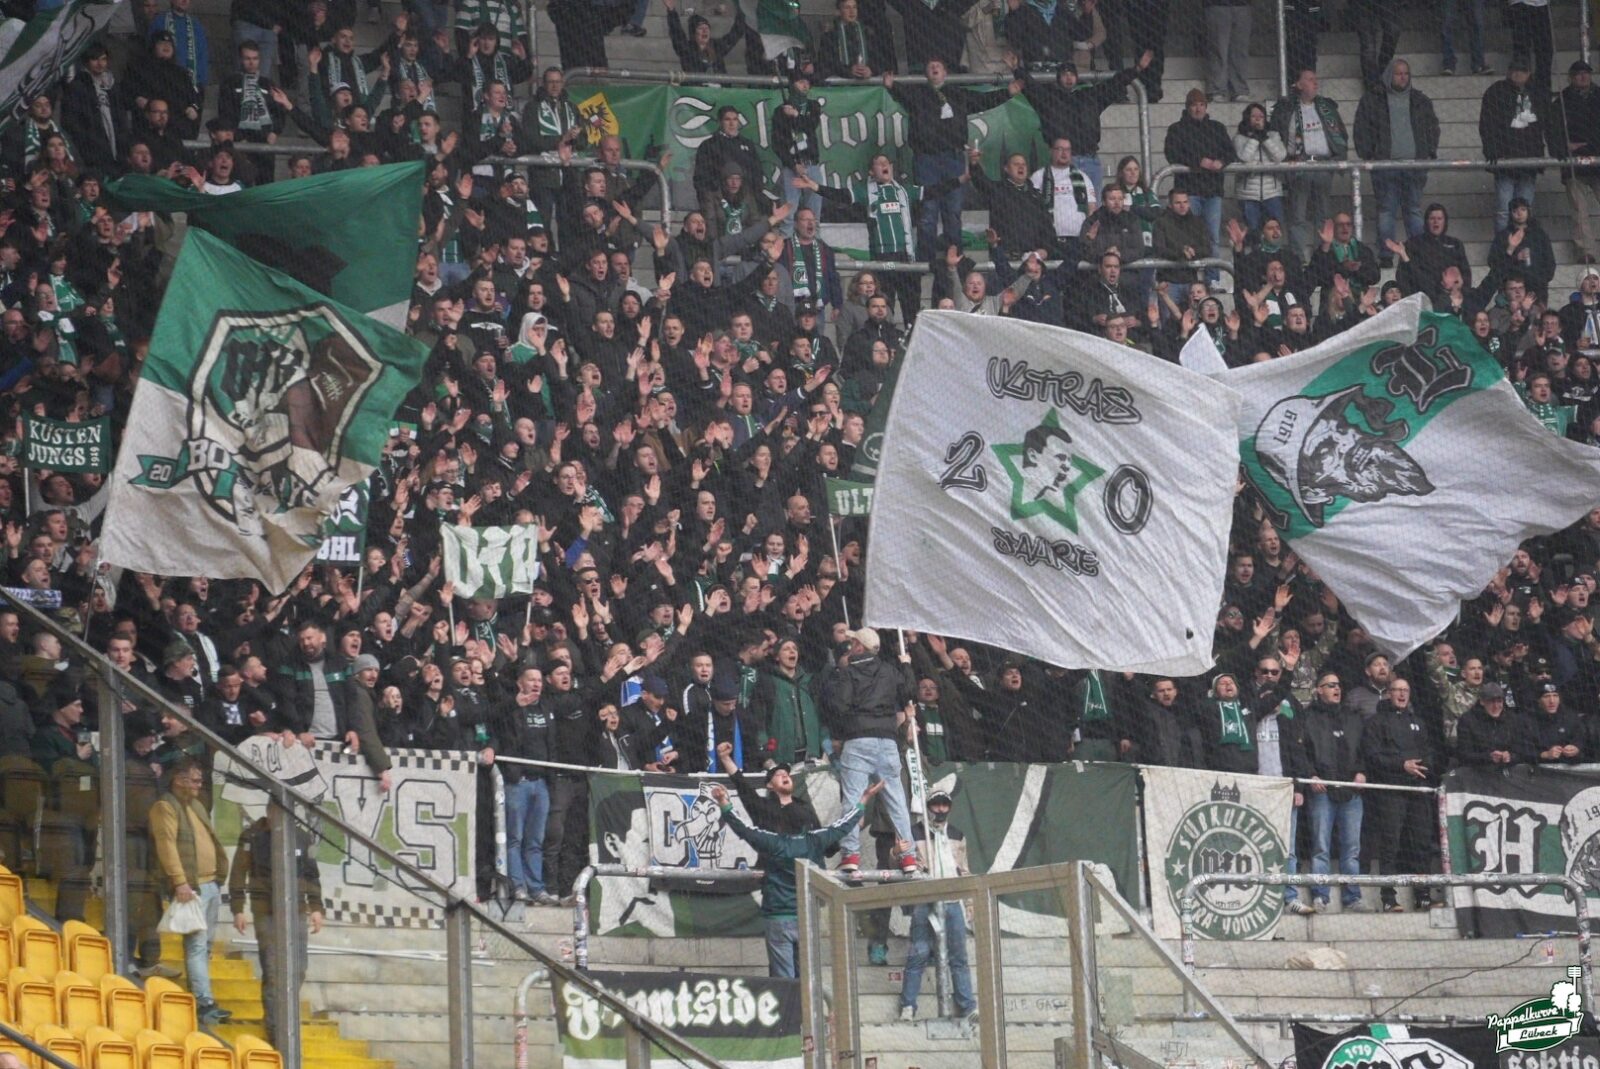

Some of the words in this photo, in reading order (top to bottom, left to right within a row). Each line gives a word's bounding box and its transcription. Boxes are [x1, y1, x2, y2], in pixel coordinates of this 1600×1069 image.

[986, 356, 1142, 425] ULTRAS
[29, 419, 102, 445] KÜSTEN
[1273, 408, 1298, 446] 1919
[28, 442, 86, 466] JUNGS
[149, 463, 171, 482] 20
[1584, 803, 1600, 821] 19
[1179, 805, 1275, 852] SUBKULTUR
[1222, 908, 1268, 935] YOUTH
[1262, 888, 1282, 911] HL
